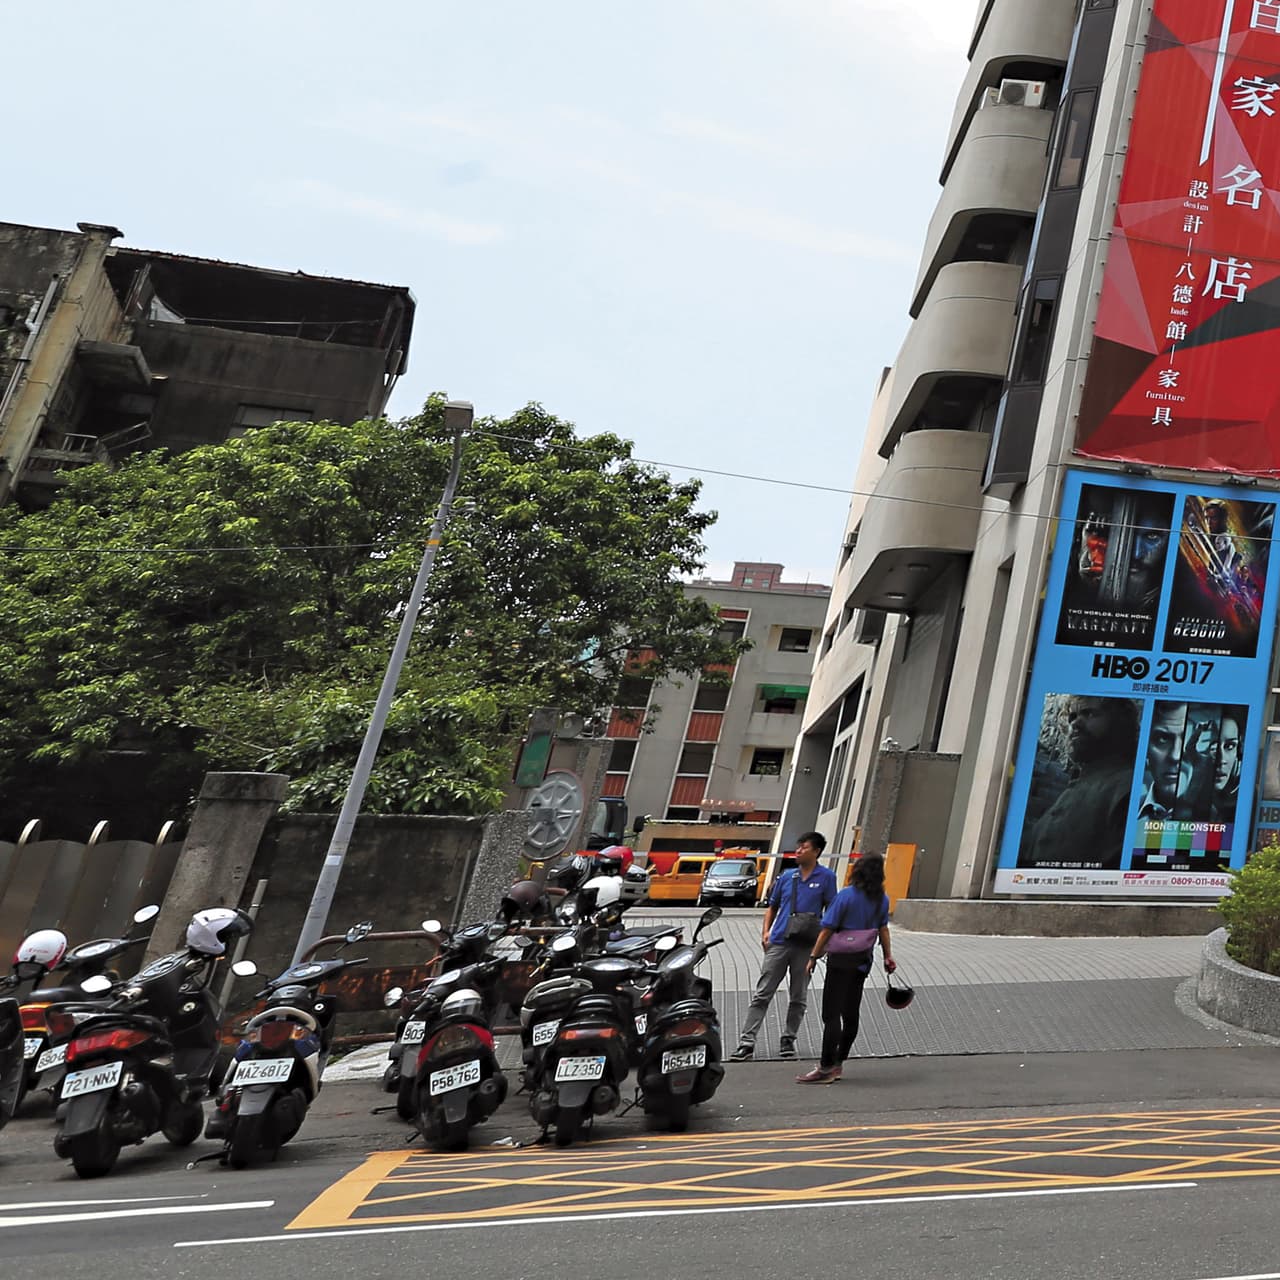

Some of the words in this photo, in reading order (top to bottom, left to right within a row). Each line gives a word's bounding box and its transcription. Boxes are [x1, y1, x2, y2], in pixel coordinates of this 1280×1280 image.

[1145, 390, 1186, 402] furniture
[1091, 653, 1150, 681] HBO
[1154, 658, 1215, 685] 2017
[1143, 821, 1180, 832] MONEY
[1181, 823, 1227, 833] MONSTER
[1170, 876, 1225, 887] 0809-011-868
[235, 1062, 291, 1083] MAZ-6812
[557, 1063, 602, 1078] LLZ-350
[65, 1069, 119, 1094] 721-NNX
[431, 1067, 479, 1093] P58-762
